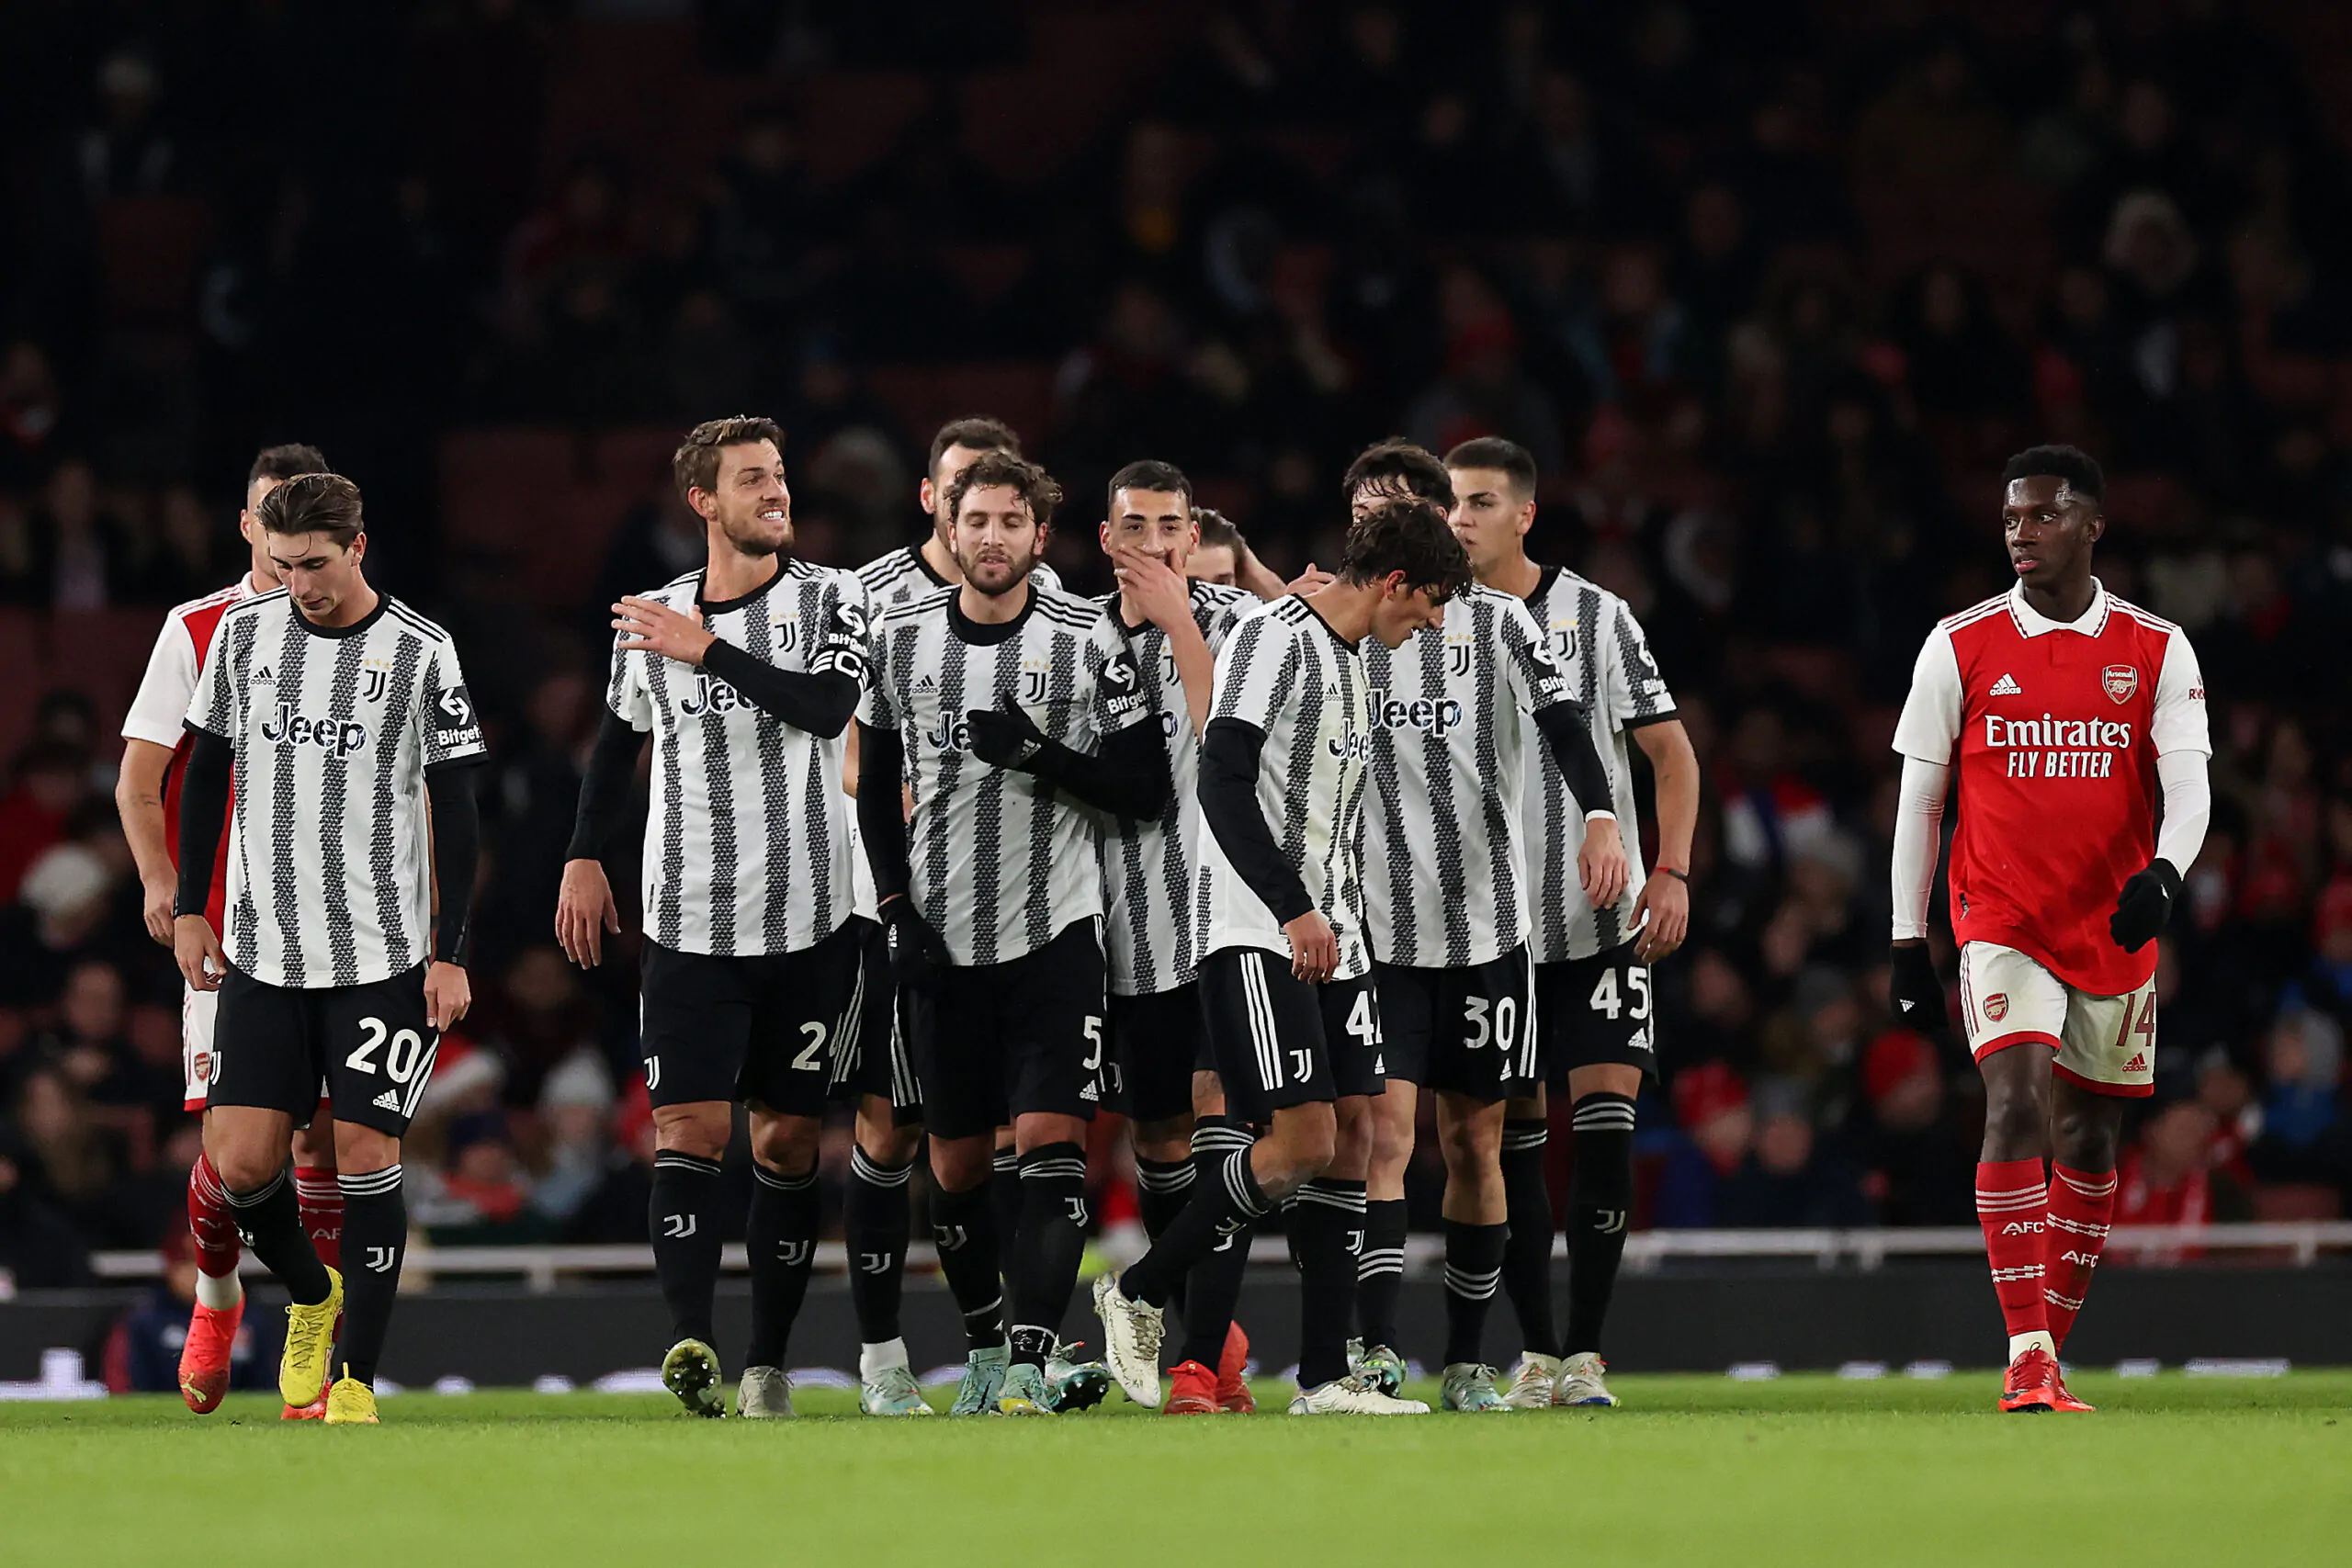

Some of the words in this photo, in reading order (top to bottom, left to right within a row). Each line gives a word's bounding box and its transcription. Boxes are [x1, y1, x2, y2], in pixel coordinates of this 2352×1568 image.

[834, 650, 862, 679] C
[1989, 686, 2022, 695] adidas
[1369, 689, 1464, 738] Jeep
[261, 702, 367, 760] Jeep
[437, 725, 480, 746] Bitget
[1985, 713, 2132, 749] Emirates
[2007, 751, 2039, 778] FLY
[2044, 751, 2112, 778] BETTER
[1589, 966, 1648, 1020] 45
[1464, 996, 1516, 1051] 30
[2116, 992, 2154, 1046] 14
[345, 1017, 422, 1084] 20
[1082, 1015, 1102, 1070] 5
[372, 1098, 401, 1112] adidas
[311, 1227, 342, 1240] AF
[2002, 1222, 2044, 1235] AFC
[2061, 1250, 2099, 1269] AFC
